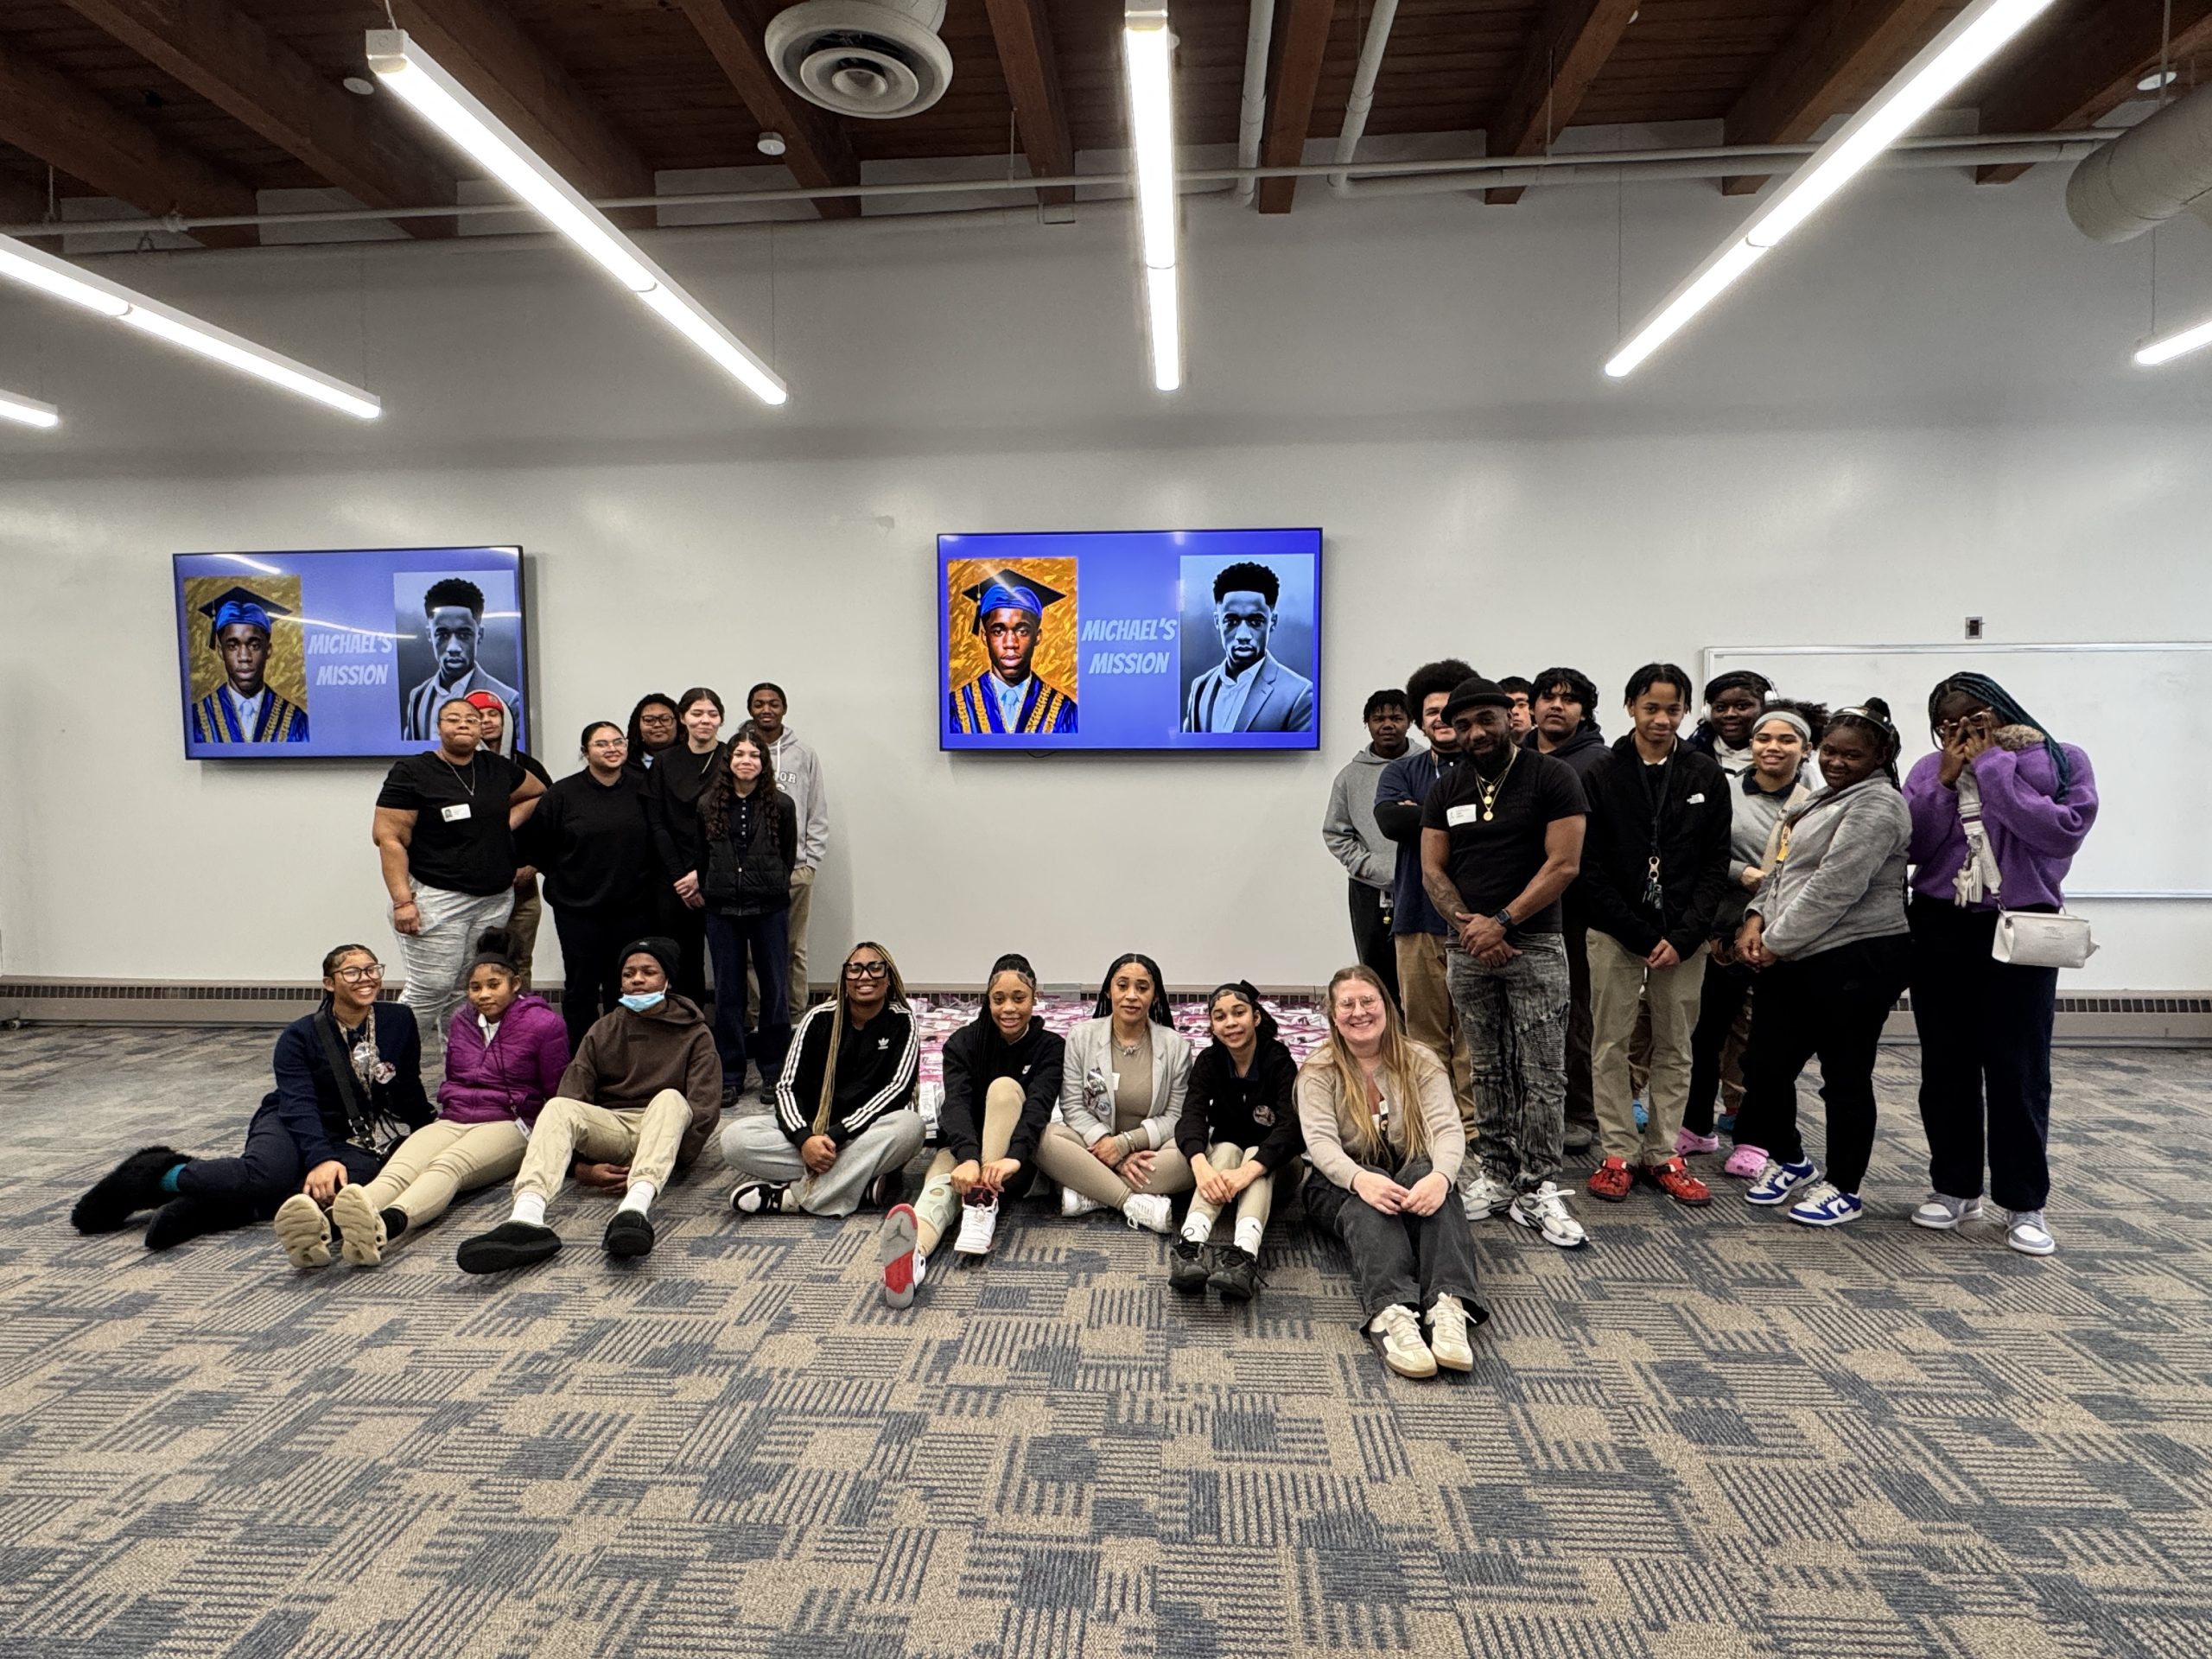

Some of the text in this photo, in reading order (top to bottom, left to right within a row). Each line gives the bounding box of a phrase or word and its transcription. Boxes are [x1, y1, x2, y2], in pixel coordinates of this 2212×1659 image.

[1081, 617, 1178, 641] MICHAEL'S
[307, 633, 393, 655] MICHAEL'S
[1088, 652, 1170, 674] MISSION
[316, 664, 389, 686] MISSION
